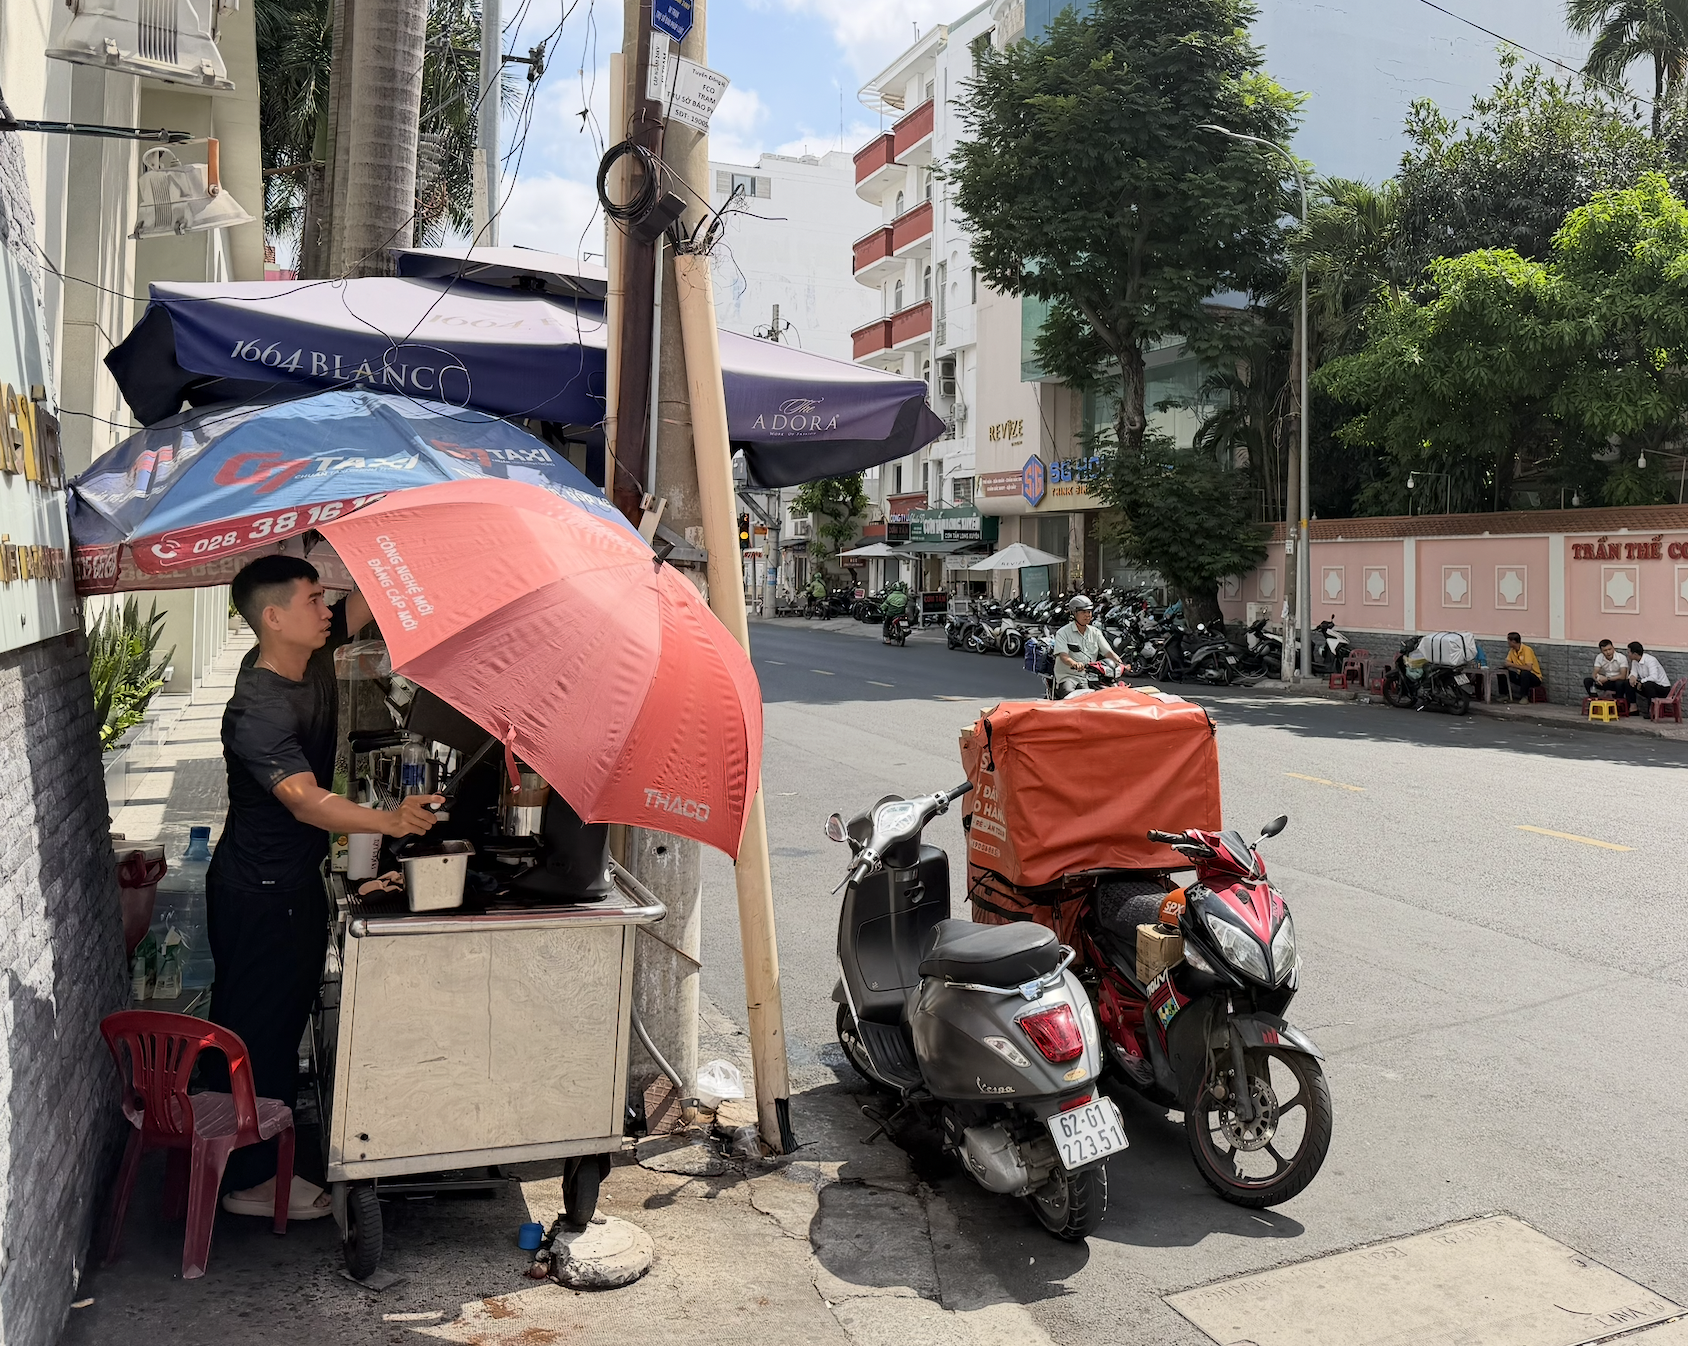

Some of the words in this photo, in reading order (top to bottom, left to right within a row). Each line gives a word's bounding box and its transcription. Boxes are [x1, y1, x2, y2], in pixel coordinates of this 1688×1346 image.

[231, 338, 304, 373] 1664
[310, 350, 435, 391] BLANC
[779, 397, 825, 415] The
[751, 413, 838, 431] ADORA
[314, 453, 420, 471] TAXI
[485, 448, 553, 462] TAXI
[1024, 464, 1044, 498] SG
[1050, 459, 1072, 484] SG
[193, 531, 242, 554] 028.
[248, 511, 299, 539] 38
[307, 502, 344, 525] 16
[375, 535, 404, 565] CÔNG
[643, 787, 712, 823] THACO
[1163, 900, 1185, 915] SPX
[976, 1076, 1016, 1095] Vespa
[1062, 1125, 1123, 1165] 223.51
